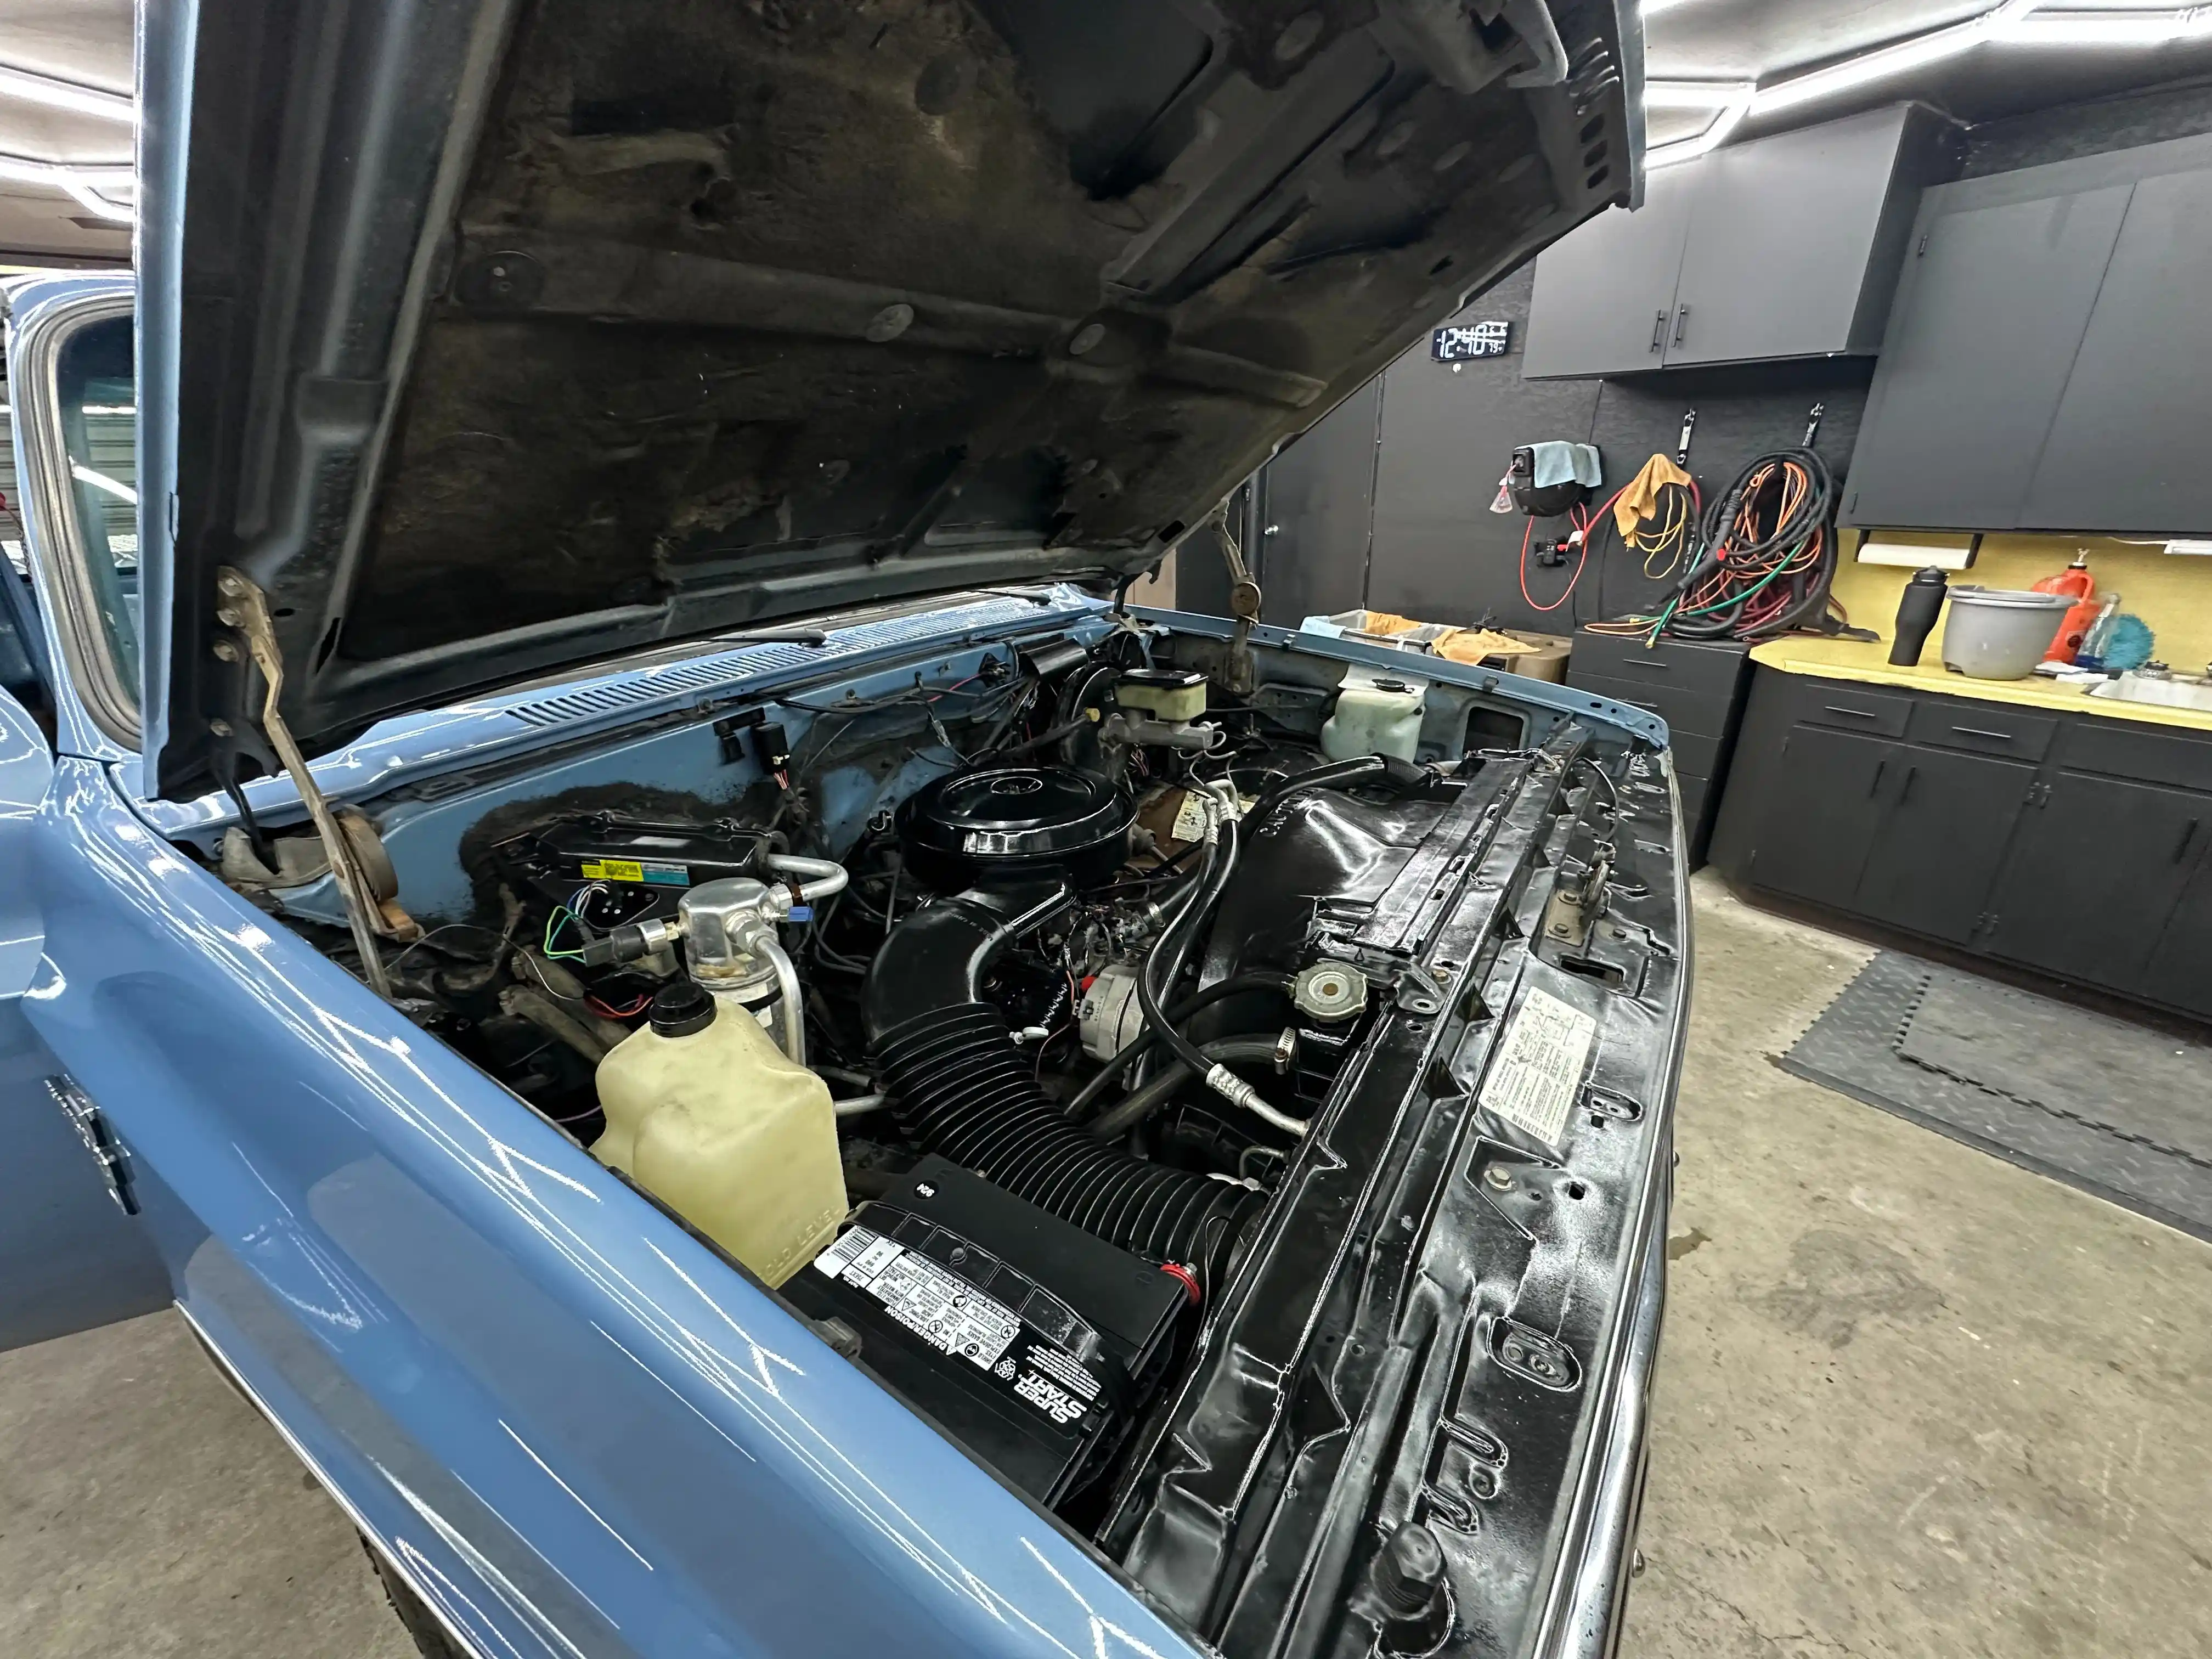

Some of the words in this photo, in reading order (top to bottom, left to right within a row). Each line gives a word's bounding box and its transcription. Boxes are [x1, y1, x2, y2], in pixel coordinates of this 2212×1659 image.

[916, 1182, 935, 1198] 924
[757, 1248, 791, 1277] OLD
[884, 1305, 947, 1351] DANGER/POISON
[967, 1330, 980, 1341] GASES
[979, 1338, 1000, 1354] EXPLOSIVE
[978, 1352, 992, 1364] SHIELD
[1012, 1380, 1070, 1424] SUPER
[1020, 1373, 1087, 1418] START
